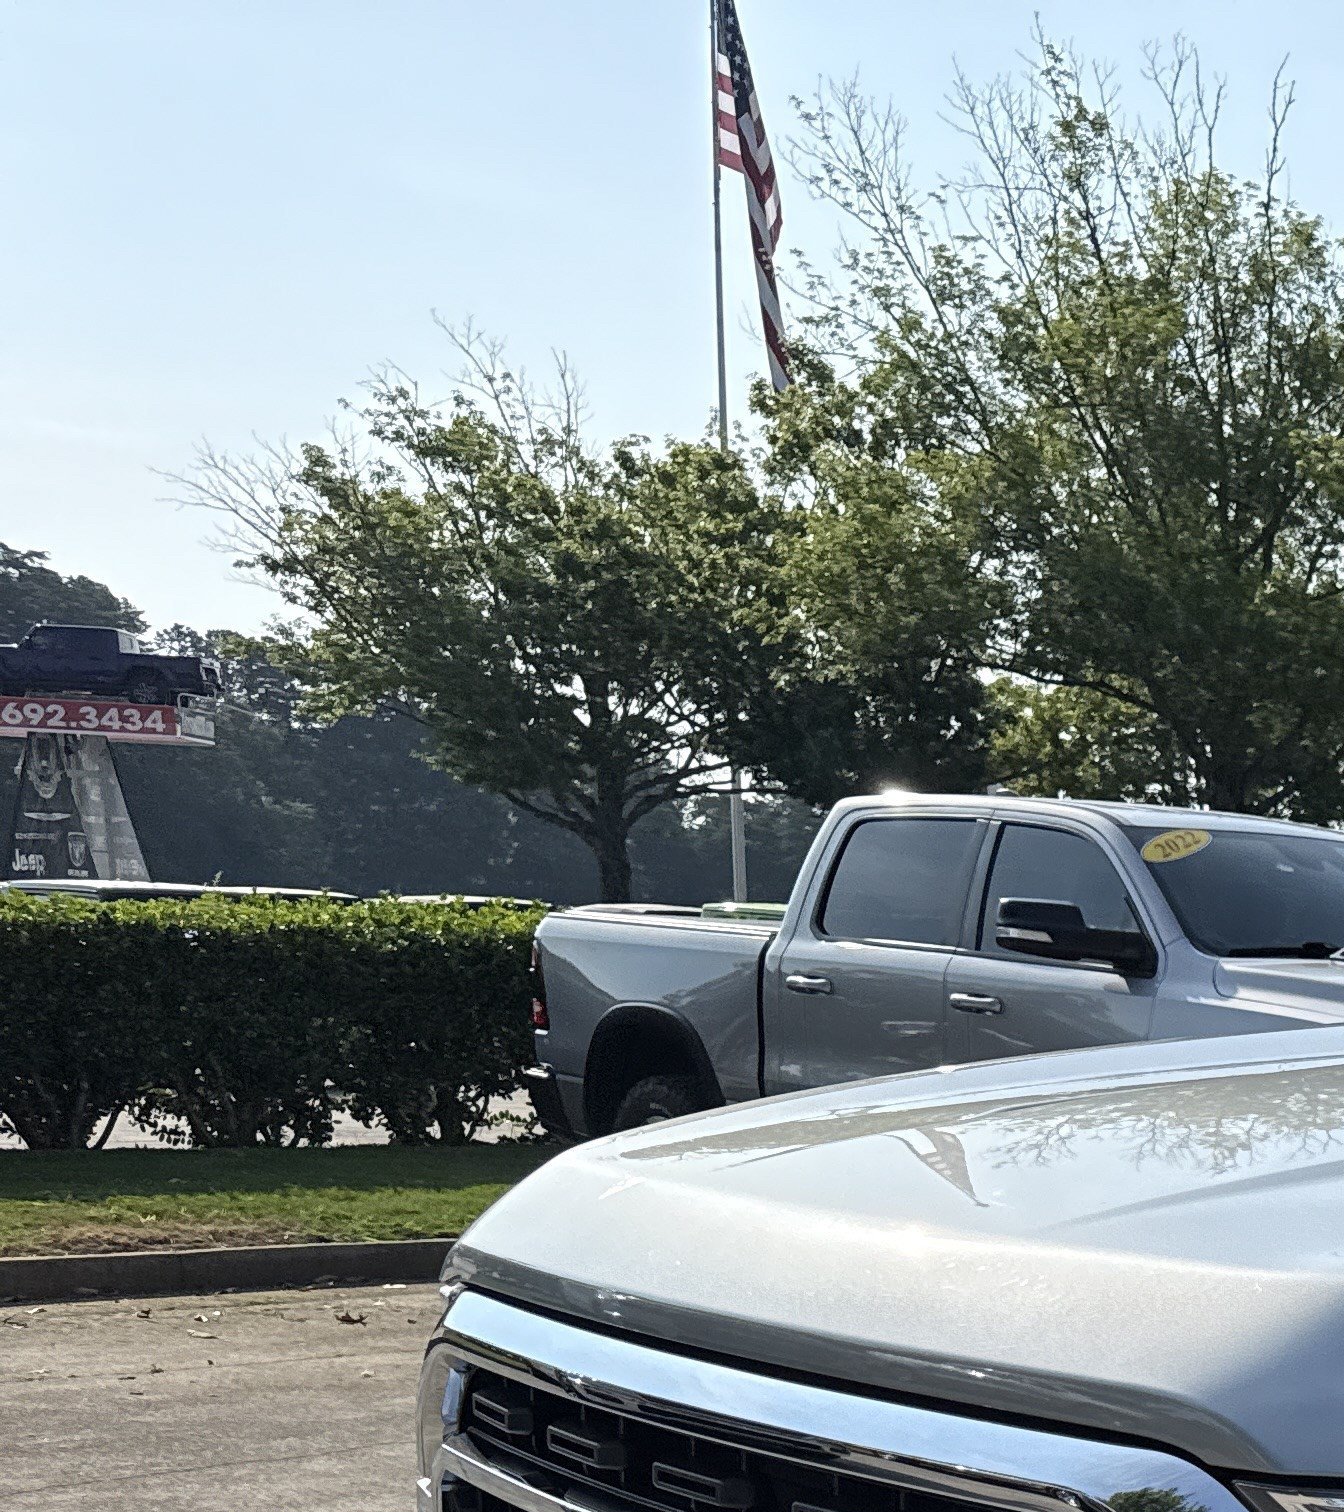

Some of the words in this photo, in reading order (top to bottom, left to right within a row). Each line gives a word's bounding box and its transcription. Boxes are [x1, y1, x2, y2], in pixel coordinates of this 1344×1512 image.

[1, 702, 166, 733] 692.3434
[1154, 831, 1201, 858] 2022
[12, 849, 46, 876] Jeep
